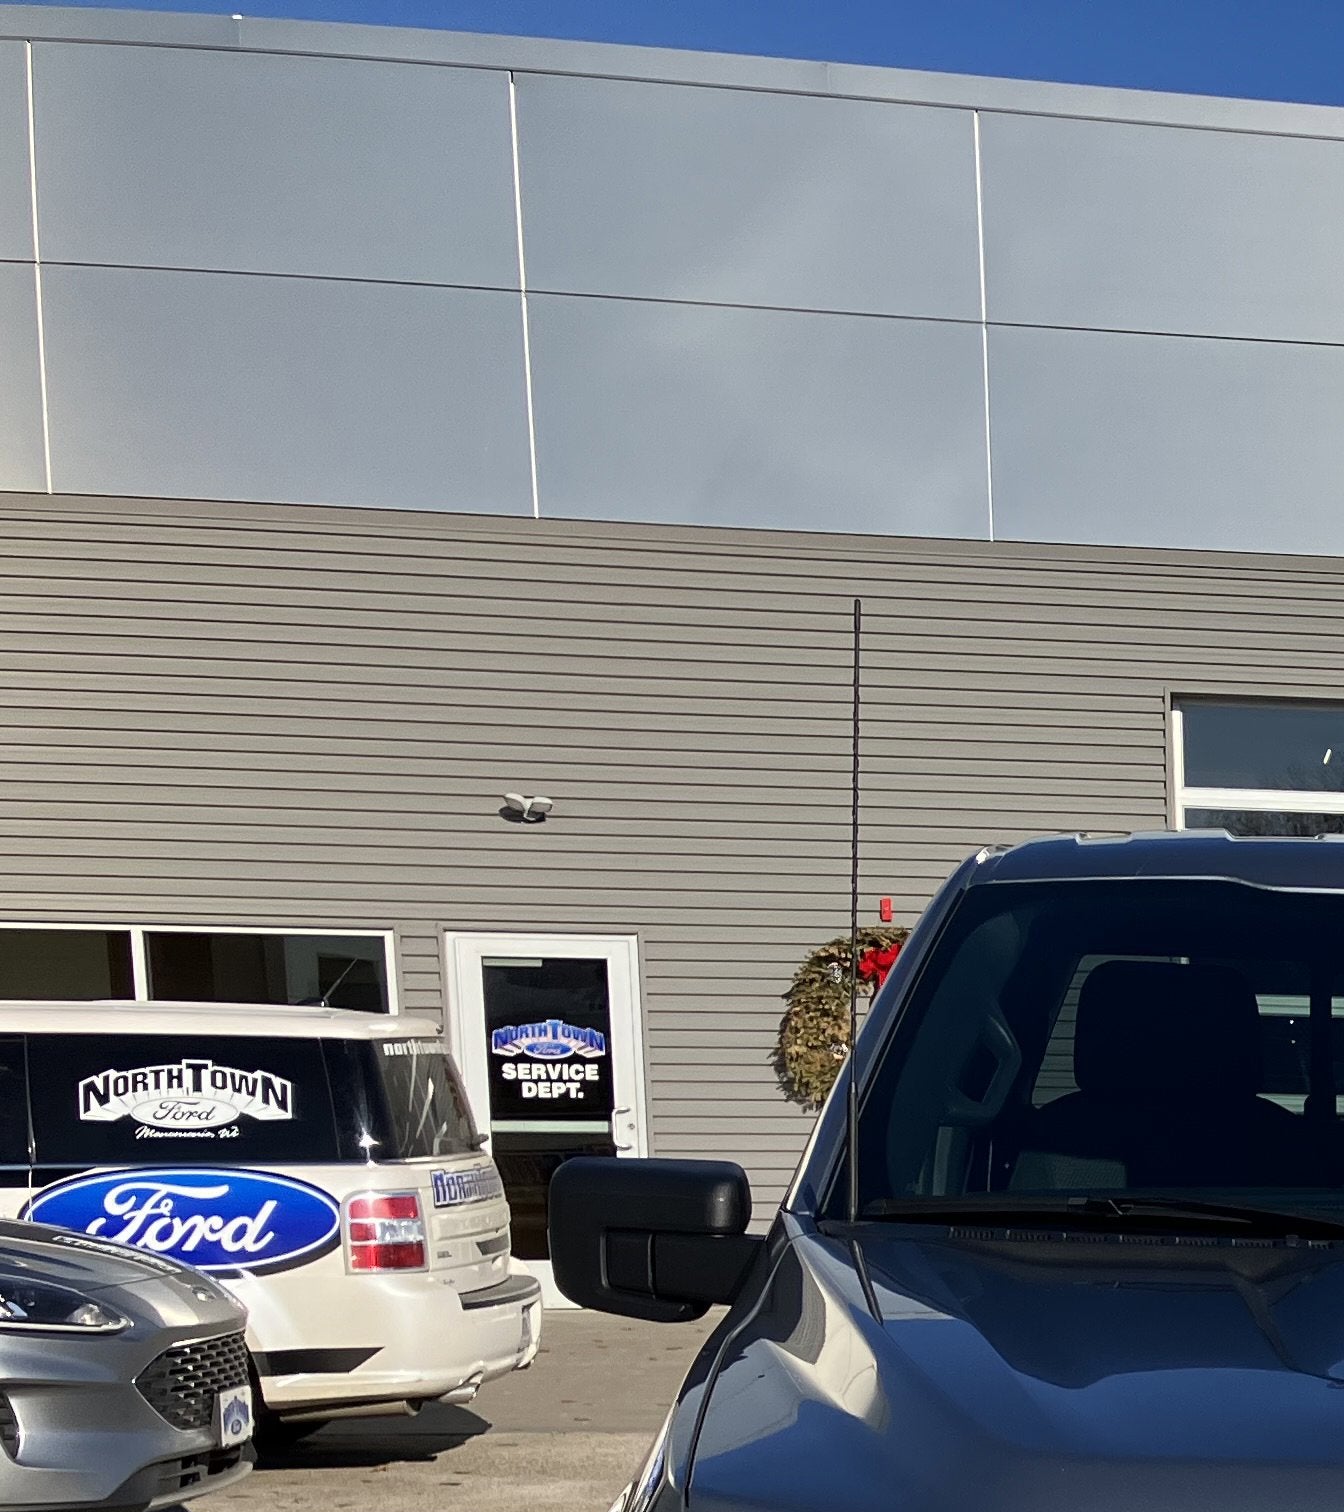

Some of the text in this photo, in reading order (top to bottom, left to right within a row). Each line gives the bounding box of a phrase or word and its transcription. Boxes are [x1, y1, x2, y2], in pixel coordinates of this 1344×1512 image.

[501, 1062, 600, 1080] SERVICE
[82, 1062, 289, 1117] NORTHTOWN
[521, 1081, 585, 1099] DEPT.
[152, 1100, 216, 1122] Ford
[86, 1182, 278, 1252] Ford
